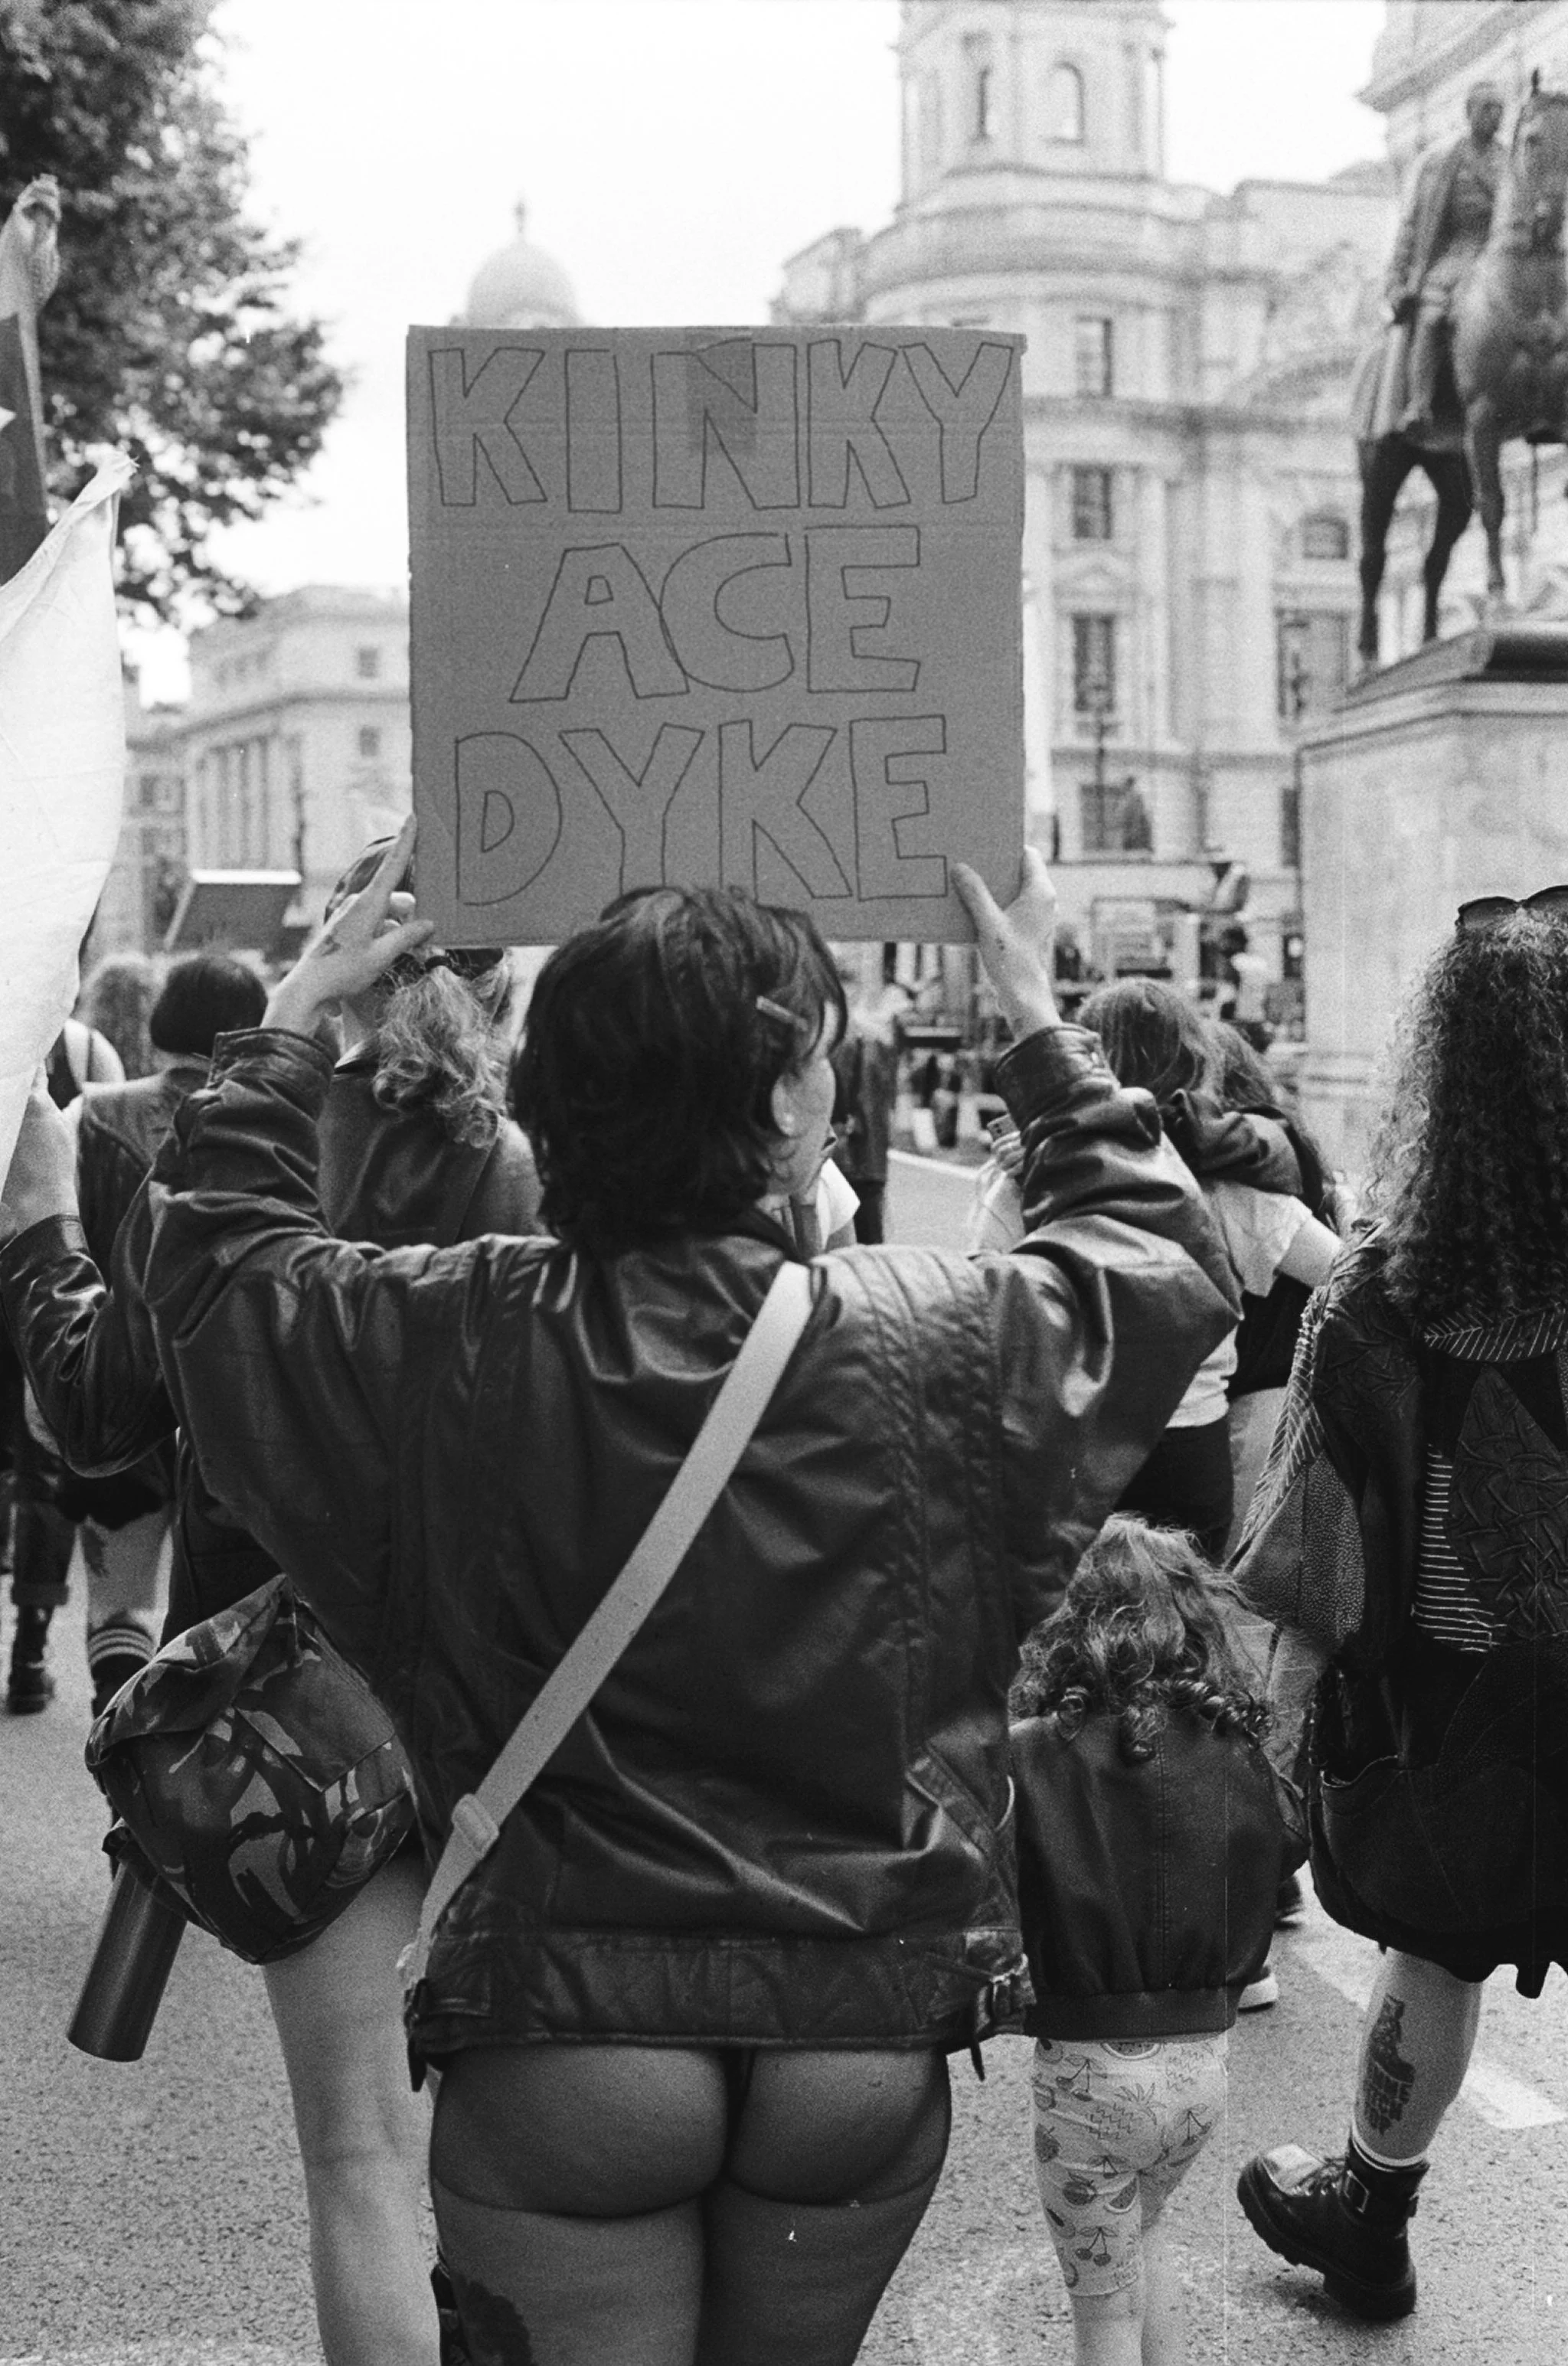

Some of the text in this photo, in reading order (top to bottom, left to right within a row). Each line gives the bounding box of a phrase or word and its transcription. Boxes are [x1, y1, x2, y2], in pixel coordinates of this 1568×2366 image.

[429, 338, 1014, 513] KINKY
[509, 525, 920, 702] ACE
[454, 714, 948, 906] DYKE
